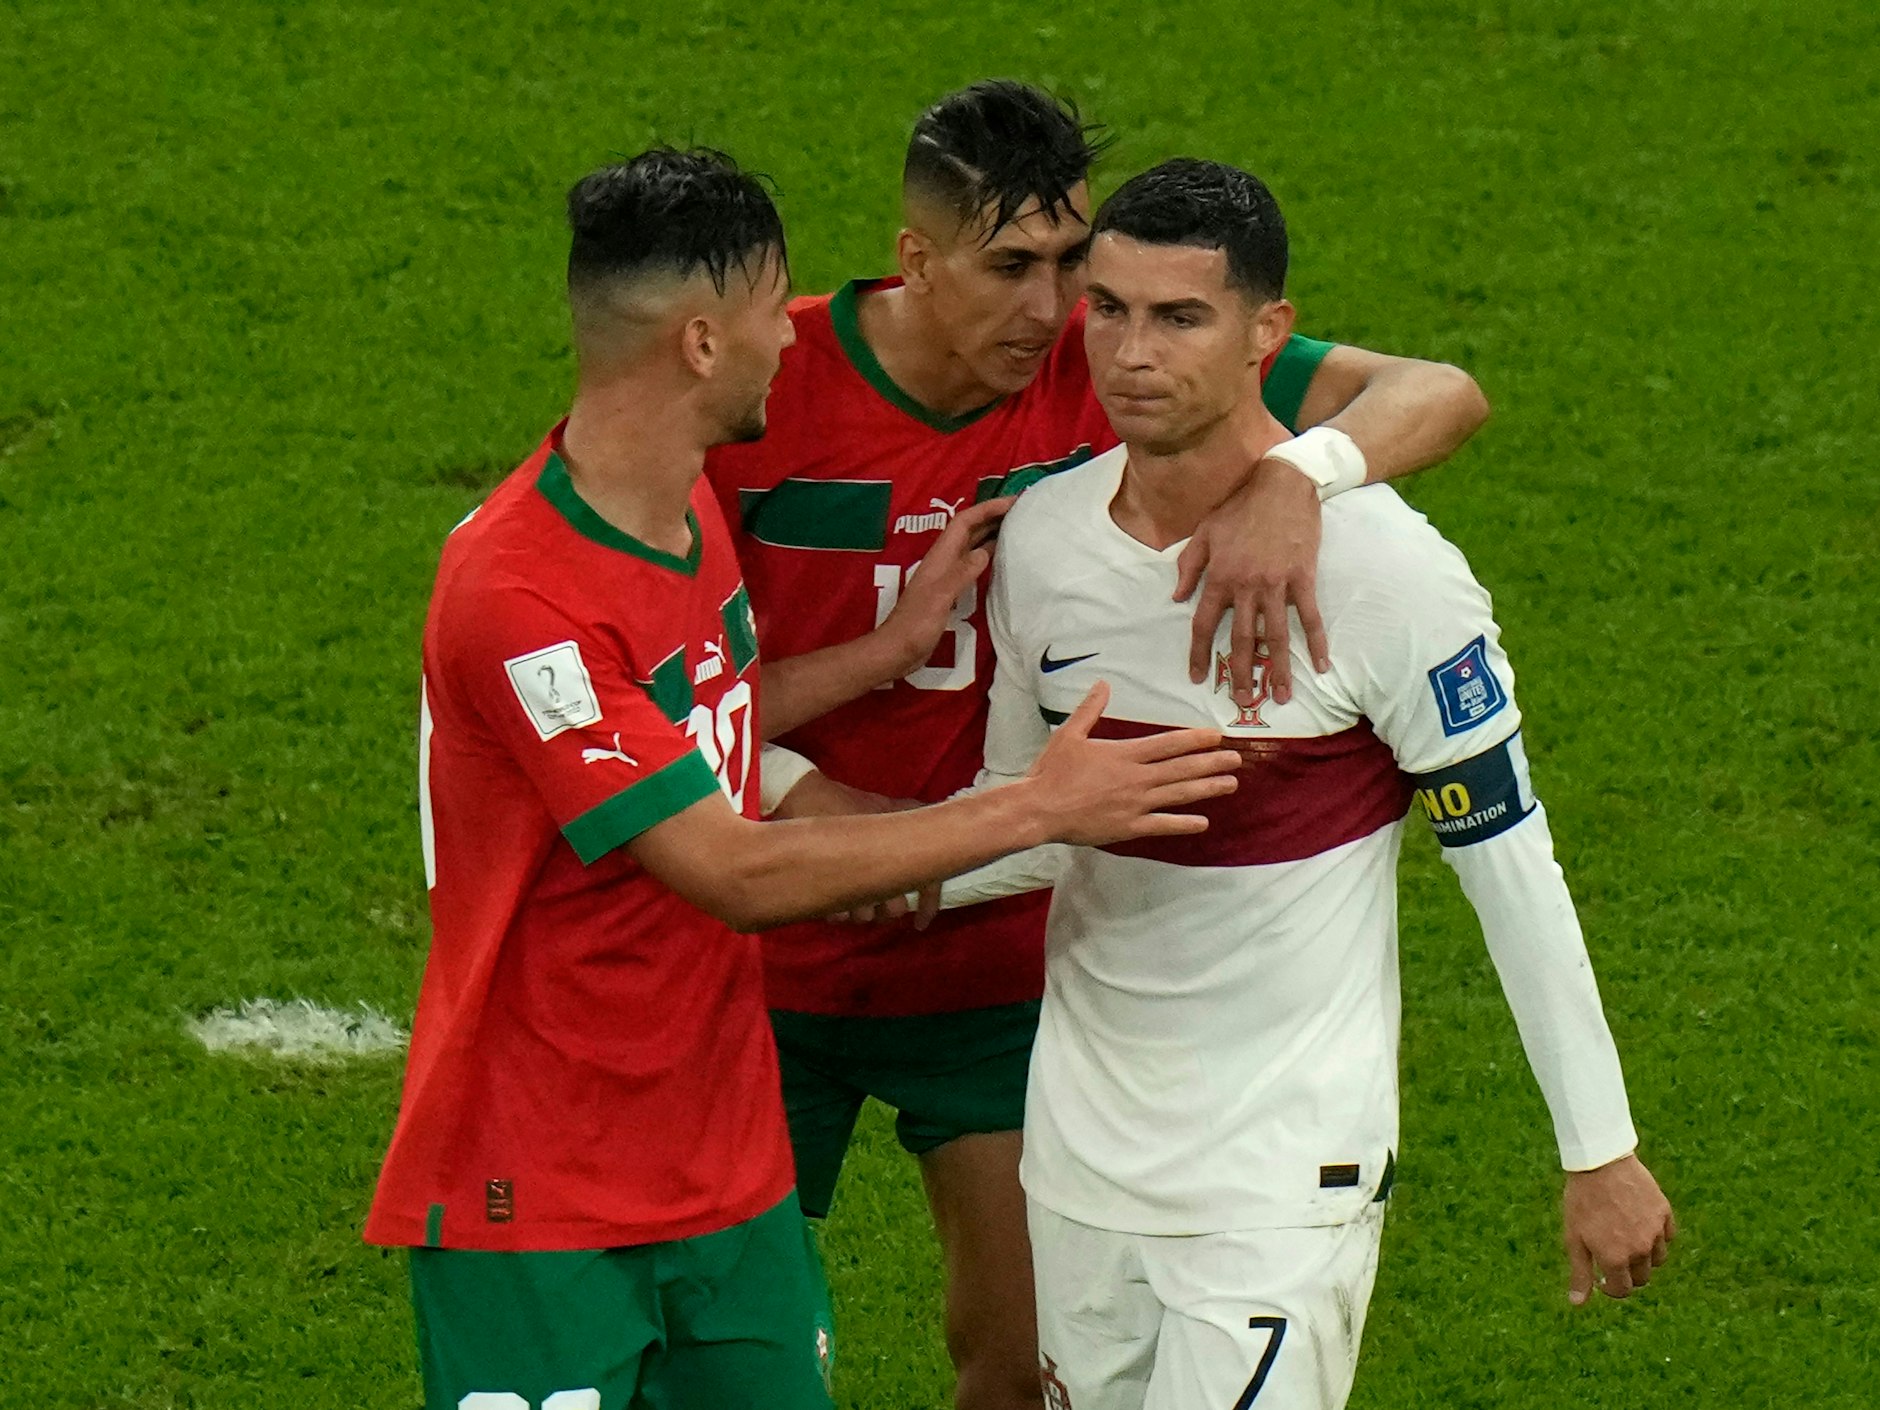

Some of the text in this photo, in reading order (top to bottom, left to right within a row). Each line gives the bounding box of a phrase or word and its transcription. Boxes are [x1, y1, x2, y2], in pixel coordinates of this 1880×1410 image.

[893, 512, 948, 534] PUMA
[1417, 782, 1471, 821] NO
[1232, 1316, 1288, 1410] 7
